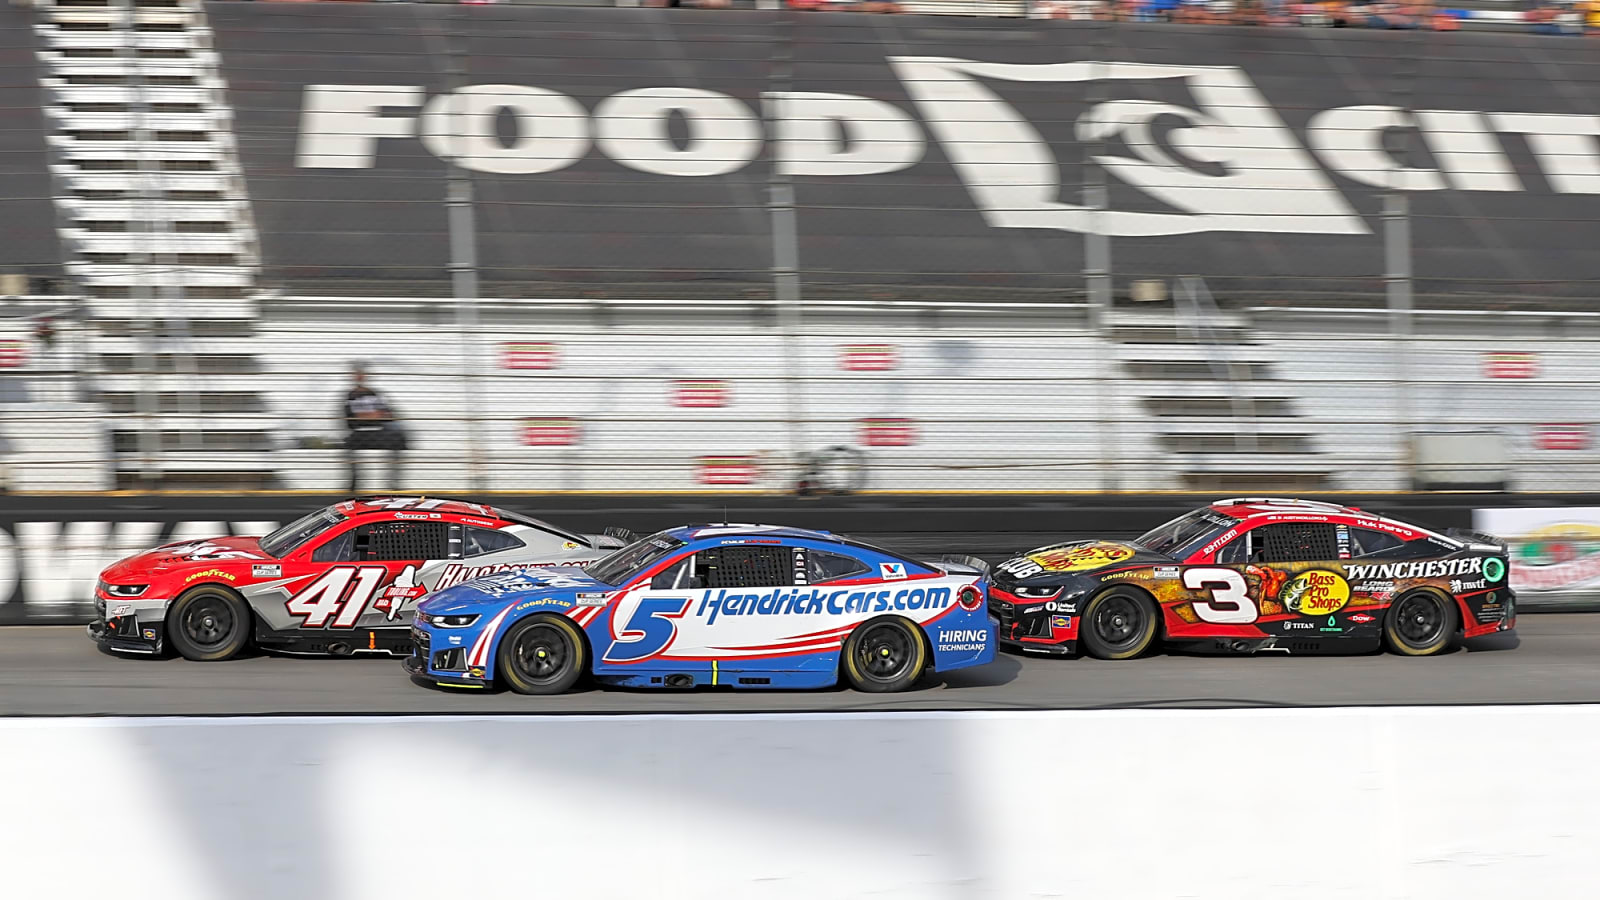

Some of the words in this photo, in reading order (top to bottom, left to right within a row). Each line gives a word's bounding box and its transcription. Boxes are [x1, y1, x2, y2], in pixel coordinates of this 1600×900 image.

[294, 84, 927, 177] FOOD
[1343, 556, 1482, 580] WINCHESTER
[185, 569, 236, 583] GOODYEAR
[1101, 571, 1150, 582] GOODYEAR
[1308, 572, 1335, 585] Bass
[287, 565, 388, 630] 41
[1183, 567, 1258, 624] 3
[1308, 585, 1329, 596] Pro
[516, 598, 572, 611] GOODYEAR
[696, 587, 951, 625] HendrickCars.com
[1308, 596, 1342, 611] Shops
[602, 597, 693, 664] 5
[939, 630, 987, 643] HIRING
[938, 643, 986, 652] TECHNICIANS
